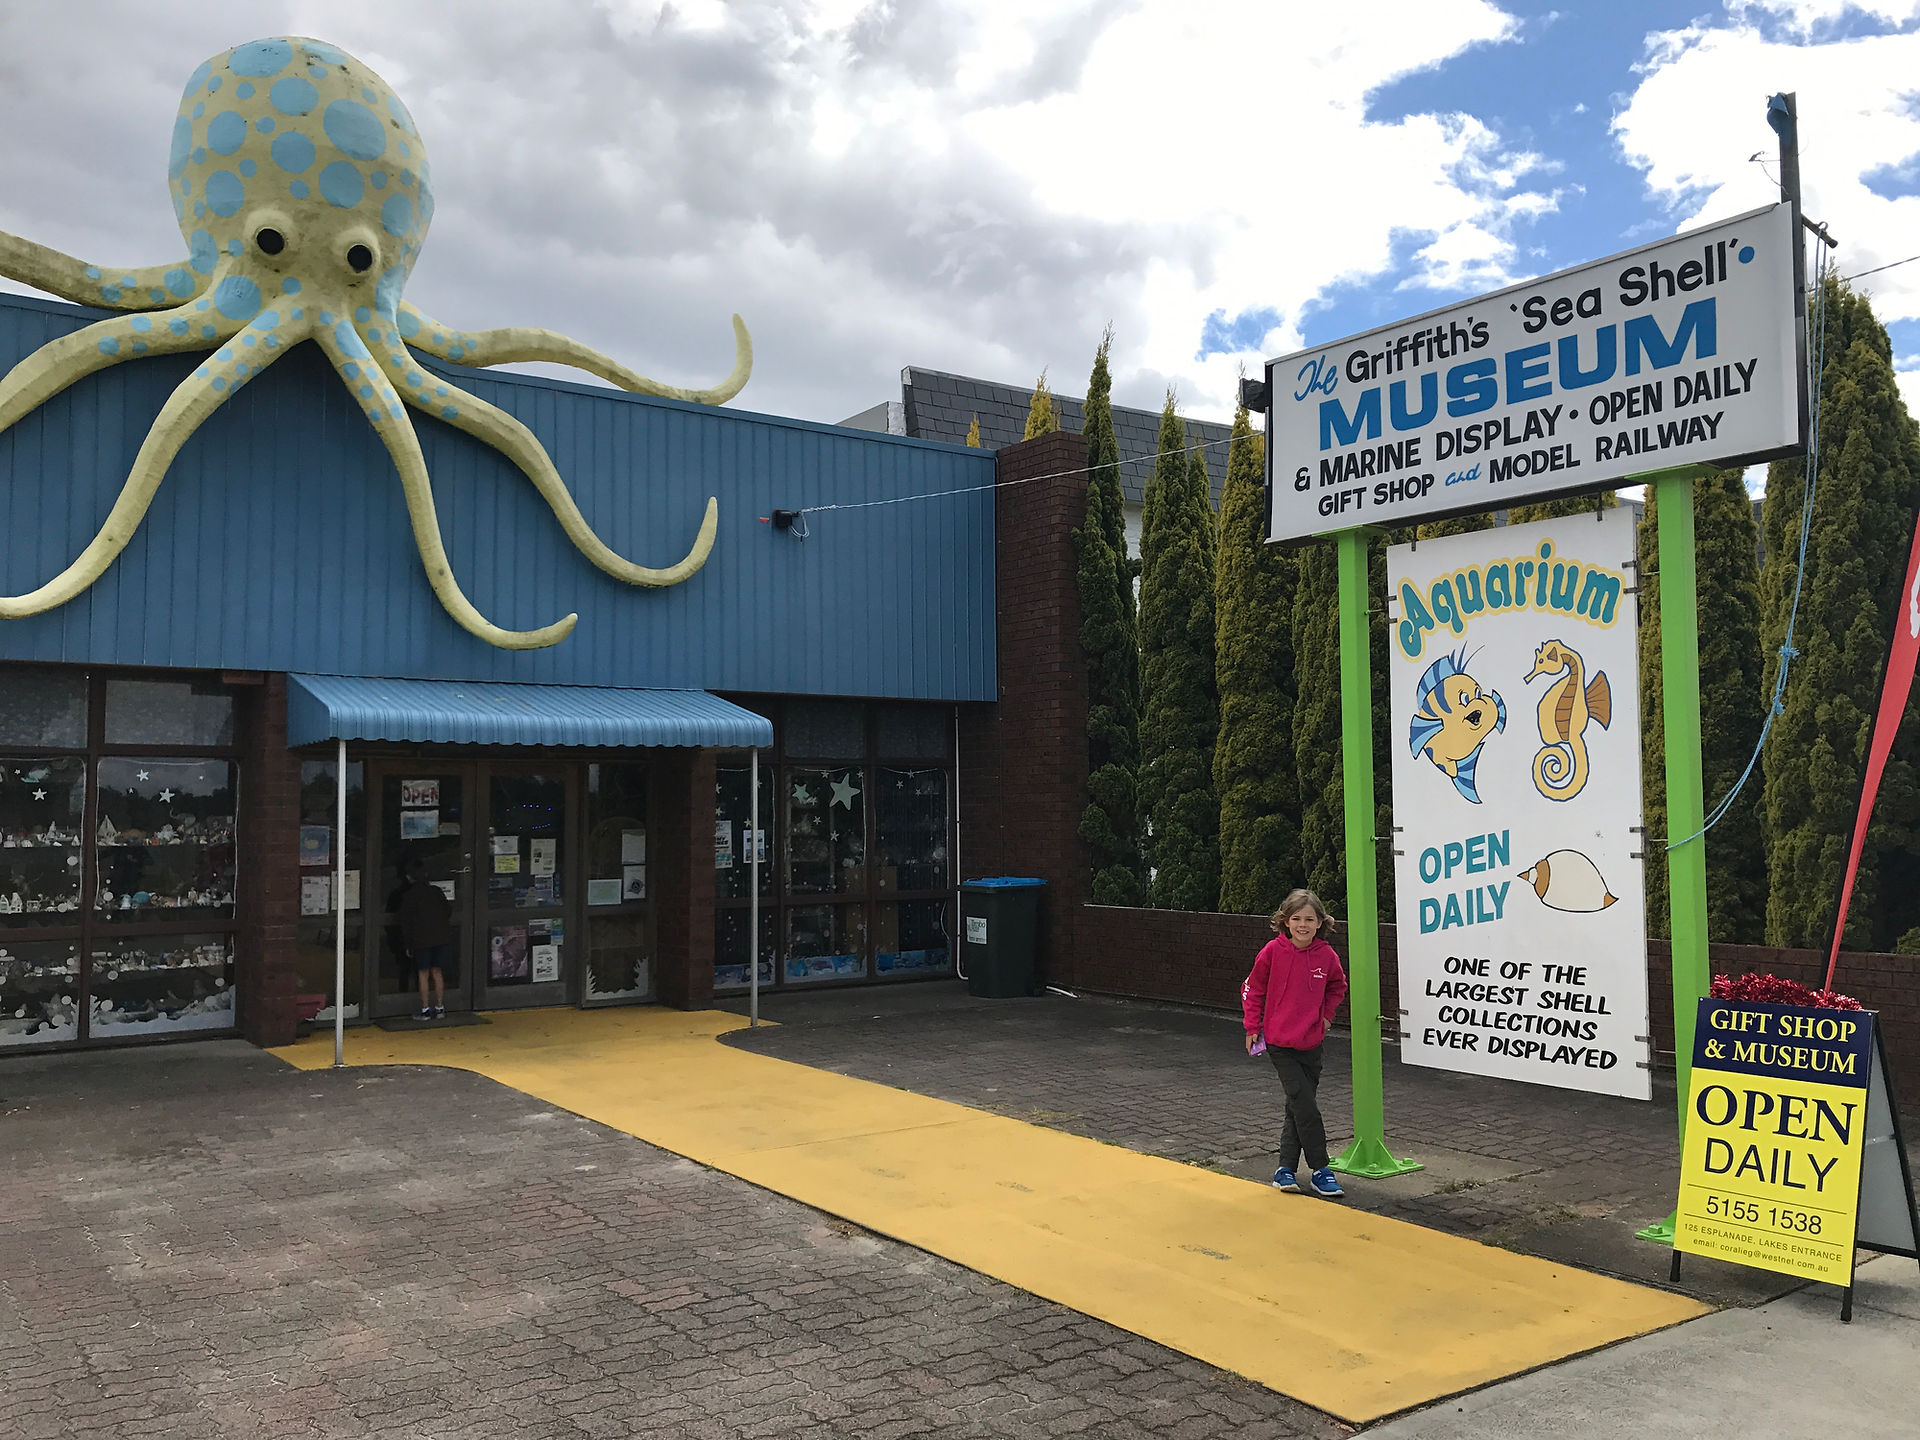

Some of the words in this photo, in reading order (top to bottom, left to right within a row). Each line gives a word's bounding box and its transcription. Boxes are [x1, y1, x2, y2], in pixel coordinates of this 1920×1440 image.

[1294, 354, 1338, 401] The
[1346, 316, 1489, 383] Griffith's
[1319, 297, 1716, 451] MUSEUM
[1294, 467, 1310, 492] &
[1319, 437, 1421, 487] MARINE
[1436, 404, 1563, 461] DISPLAY
[1590, 381, 1662, 425] OPEN
[1674, 358, 1758, 408] DAILY
[1318, 487, 1366, 516] GIFT
[1373, 473, 1434, 505] SHOP
[1444, 463, 1482, 487] and
[1489, 444, 1580, 483] MODEL
[1595, 411, 1724, 462] RAILWAY
[1397, 540, 1622, 659] Aquarium
[1419, 829, 1510, 884] OPEN
[1419, 881, 1511, 934] DAILY
[1444, 956, 1490, 977] ONE
[1500, 961, 1532, 981] OF
[1541, 964, 1587, 986] THE
[1425, 979, 1529, 1006] LARGEST
[1537, 990, 1612, 1015] SHELL
[1438, 1004, 1598, 1041] COLLECTIONS
[1710, 1008, 1773, 1034] GIFT
[1778, 1015, 1857, 1043] SHOP
[1423, 1028, 1479, 1051] EVER
[1488, 1036, 1618, 1070] DISPLAYED
[1704, 1039, 1726, 1059] &
[1732, 1041, 1858, 1075] MUSEUM
[1696, 1085, 1858, 1146] OPEN
[1704, 1137, 1839, 1192] DAILY
[1706, 1196, 1759, 1222] 5155
[1769, 1207, 1822, 1235] 1538
[1684, 1223, 1698, 1233] 125
[1759, 1238, 1788, 1251] LAKES
[1791, 1245, 1842, 1262] ENTRANCE
[1693, 1237, 1718, 1249] email:
[1720, 1243, 1829, 1273] coralieg@westnet.com.au
